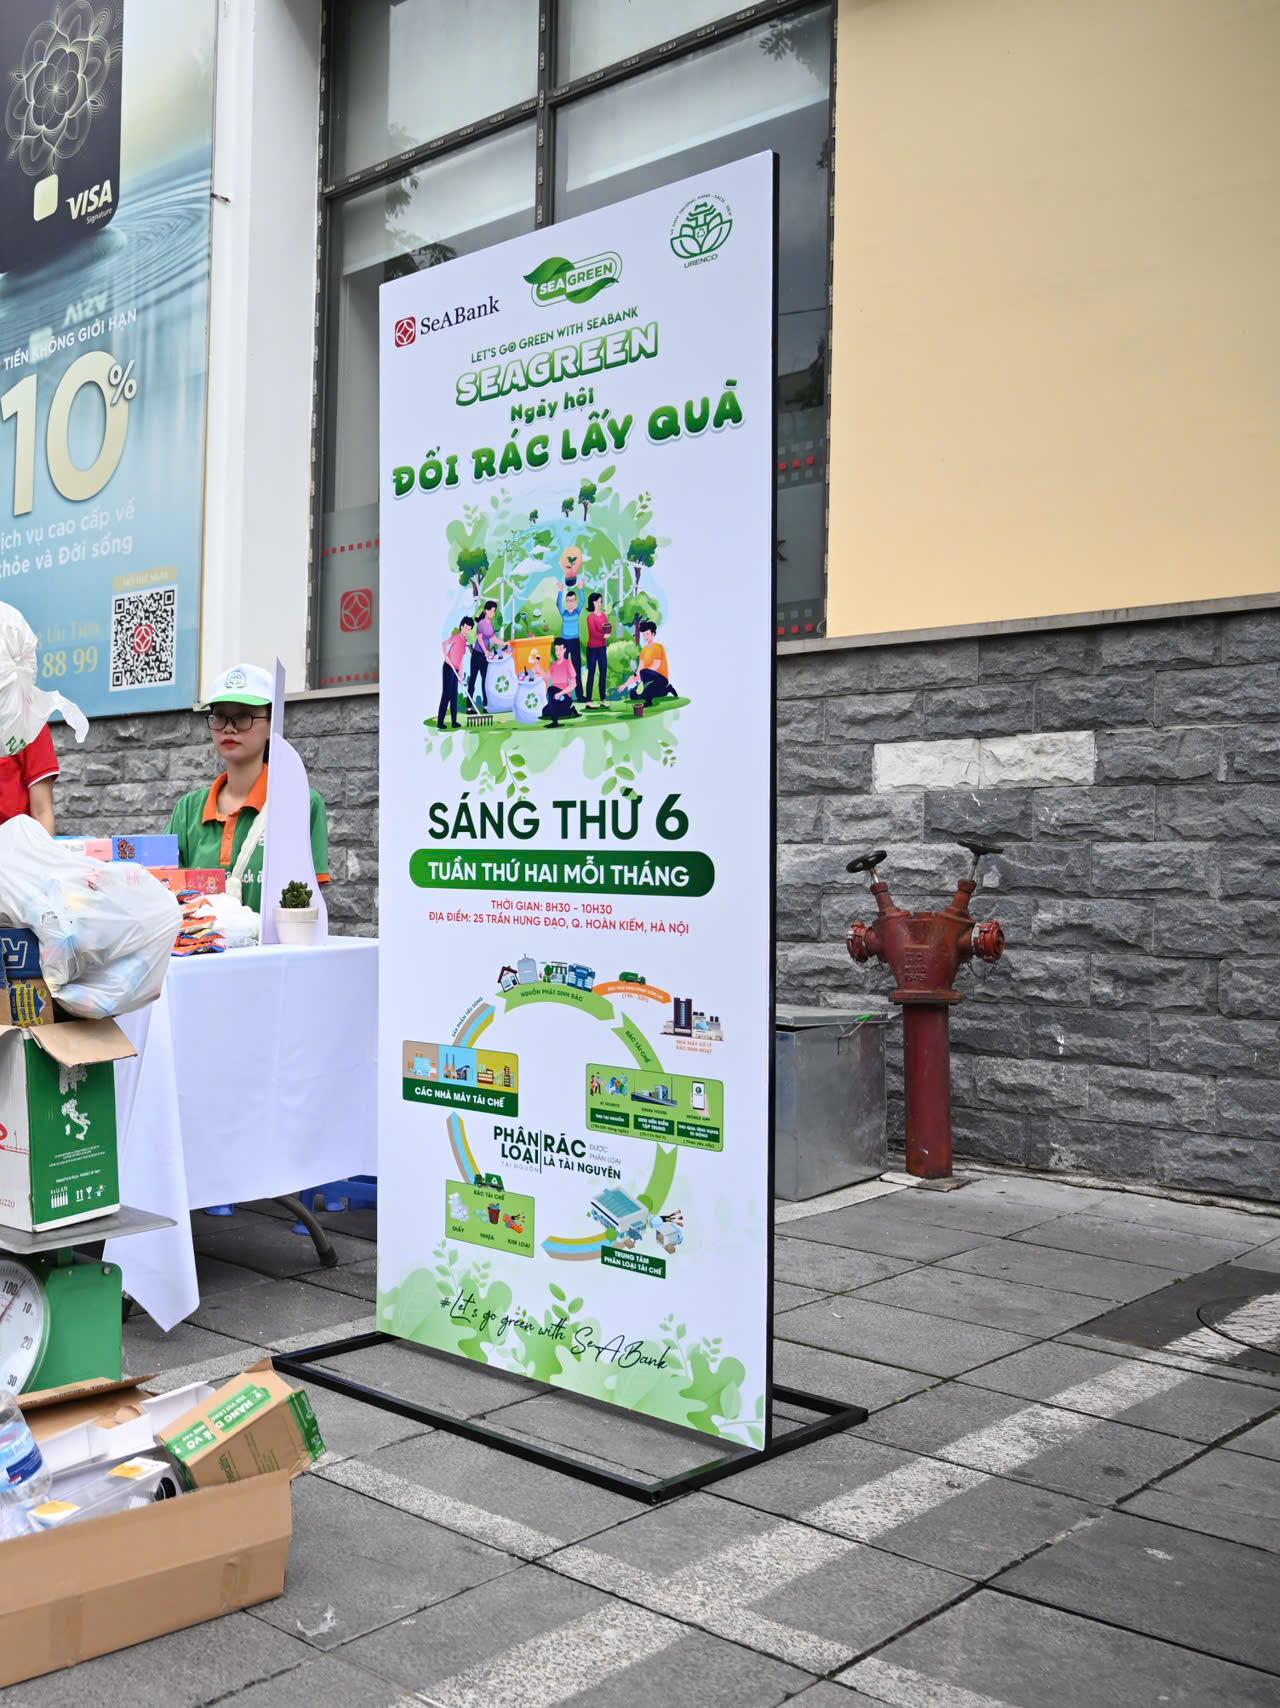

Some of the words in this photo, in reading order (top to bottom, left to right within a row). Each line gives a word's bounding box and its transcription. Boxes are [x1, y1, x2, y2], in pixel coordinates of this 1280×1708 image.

[65, 179, 113, 220] VISA
[86, 208, 113, 225] Signature
[683, 253, 719, 269] URENCO
[539, 277, 566, 295] SEA
[566, 261, 614, 287] GREEN
[420, 295, 500, 336] SeABank
[3, 347, 29, 371] TIỀN
[77, 318, 105, 342] GIỚI
[108, 308, 137, 332] HẠN
[470, 346, 497, 363] LET'S
[498, 341, 517, 355] GO
[519, 330, 554, 350] GREEN
[556, 321, 584, 339] WITH
[586, 305, 639, 331] SEABANK
[455, 320, 659, 407] SEAGREEN
[510, 398, 559, 426] Ngày
[563, 386, 595, 413] hội
[392, 446, 461, 498] ĐỔI
[472, 428, 551, 481] RÁC
[560, 408, 634, 462] LẤY
[647, 378, 745, 441] QUÀ
[25, 526, 44, 546] vụ
[47, 518, 76, 539] cao
[80, 504, 111, 531] cấp
[115, 497, 136, 522] về
[35, 548, 54, 571] và
[57, 540, 88, 566] Đời
[90, 531, 134, 559] sống
[41, 650, 67, 679] 88
[72, 645, 99, 674] 99
[427, 791, 541, 841] SÁNG
[552, 787, 644, 841] THỨ
[655, 793, 690, 841] 6
[427, 855, 478, 882] TUẦN
[480, 858, 521, 883] THỨ
[523, 861, 559, 884] HAI
[563, 855, 605, 886] MỖI
[609, 859, 691, 888] THÁNG
[490, 897, 515, 911] THỜI
[515, 900, 544, 912] GIAN:
[545, 901, 571, 913] 8H30
[581, 903, 613, 915] 10H30
[428, 911, 445, 925] ĐỊA
[446, 910, 472, 923] ĐIỂM:
[473, 913, 485, 924] 25
[486, 911, 511, 925] TRẦN
[512, 914, 542, 927] HƯNG
[543, 915, 570, 931] ĐẠO,
[571, 917, 584, 929] Q.
[585, 917, 617, 931] HOÀN
[618, 918, 648, 934] KIẾM,
[649, 920, 667, 934] HÀ
[668, 922, 690, 937] NỘI
[414, 1085, 433, 1097] CÁC
[434, 1088, 452, 1100] NHÀ
[453, 1091, 472, 1103] MÁY
[472, 1093, 486, 1105] TÁI
[487, 1095, 506, 1108] CHẾ
[493, 1125, 539, 1148] PHÂN
[543, 1132, 587, 1159] RÁC
[501, 1142, 539, 1165] LOẠI
[543, 1153, 557, 1168] LÀ
[558, 1157, 575, 1172] TÀI
[577, 1161, 622, 1181] NGUYÊN
[603, 1256, 621, 1266] PHÂN
[621, 1260, 637, 1271] LOẠI
[637, 1263, 648, 1273] TÁI
[648, 1266, 664, 1276] CHẾ
[614, 1250, 635, 1261] TRUNG
[635, 1254, 650, 1264] TÂM
[2, 1280, 19, 1296] 100
[22, 1302, 32, 1314] 10
[20, 1335, 34, 1351] 20
[478, 1311, 497, 1331] go
[496, 1312, 535, 1337] green
[537, 1316, 566, 1341] with
[570, 1325, 671, 1370] SeABank
[6, 1374, 18, 1387] 30
